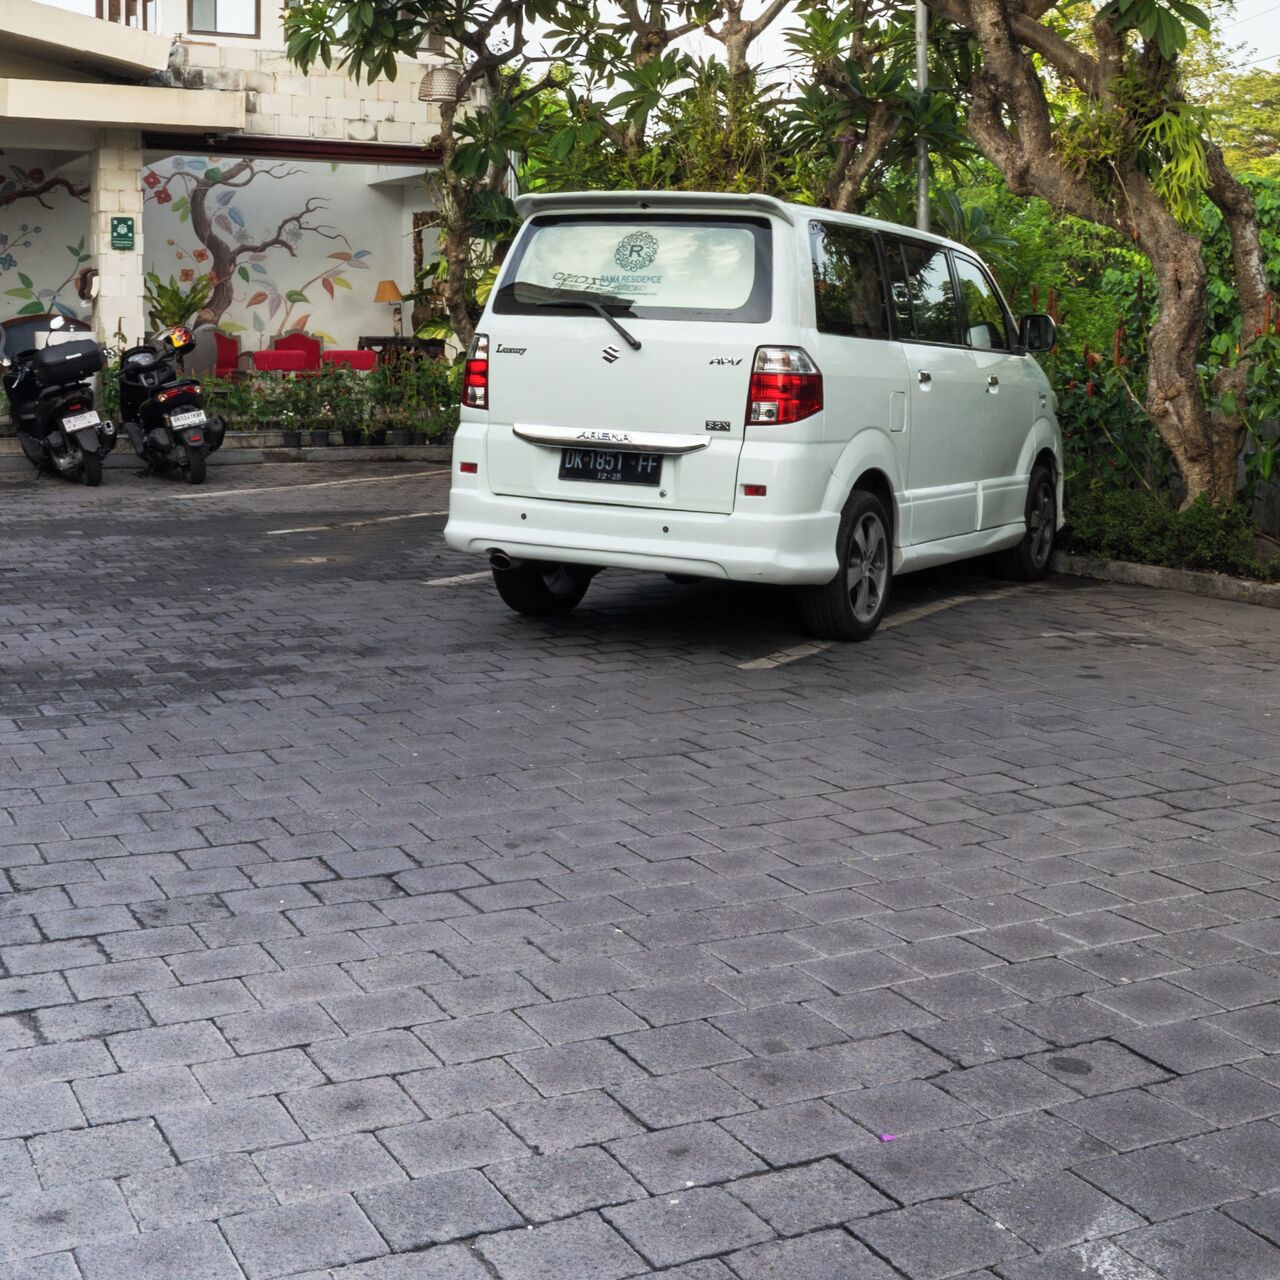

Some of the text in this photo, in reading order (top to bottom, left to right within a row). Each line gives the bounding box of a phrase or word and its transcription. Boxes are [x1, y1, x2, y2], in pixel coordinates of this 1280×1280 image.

[629, 244, 644, 258] R
[564, 450, 657, 473] DK 1851 FF
